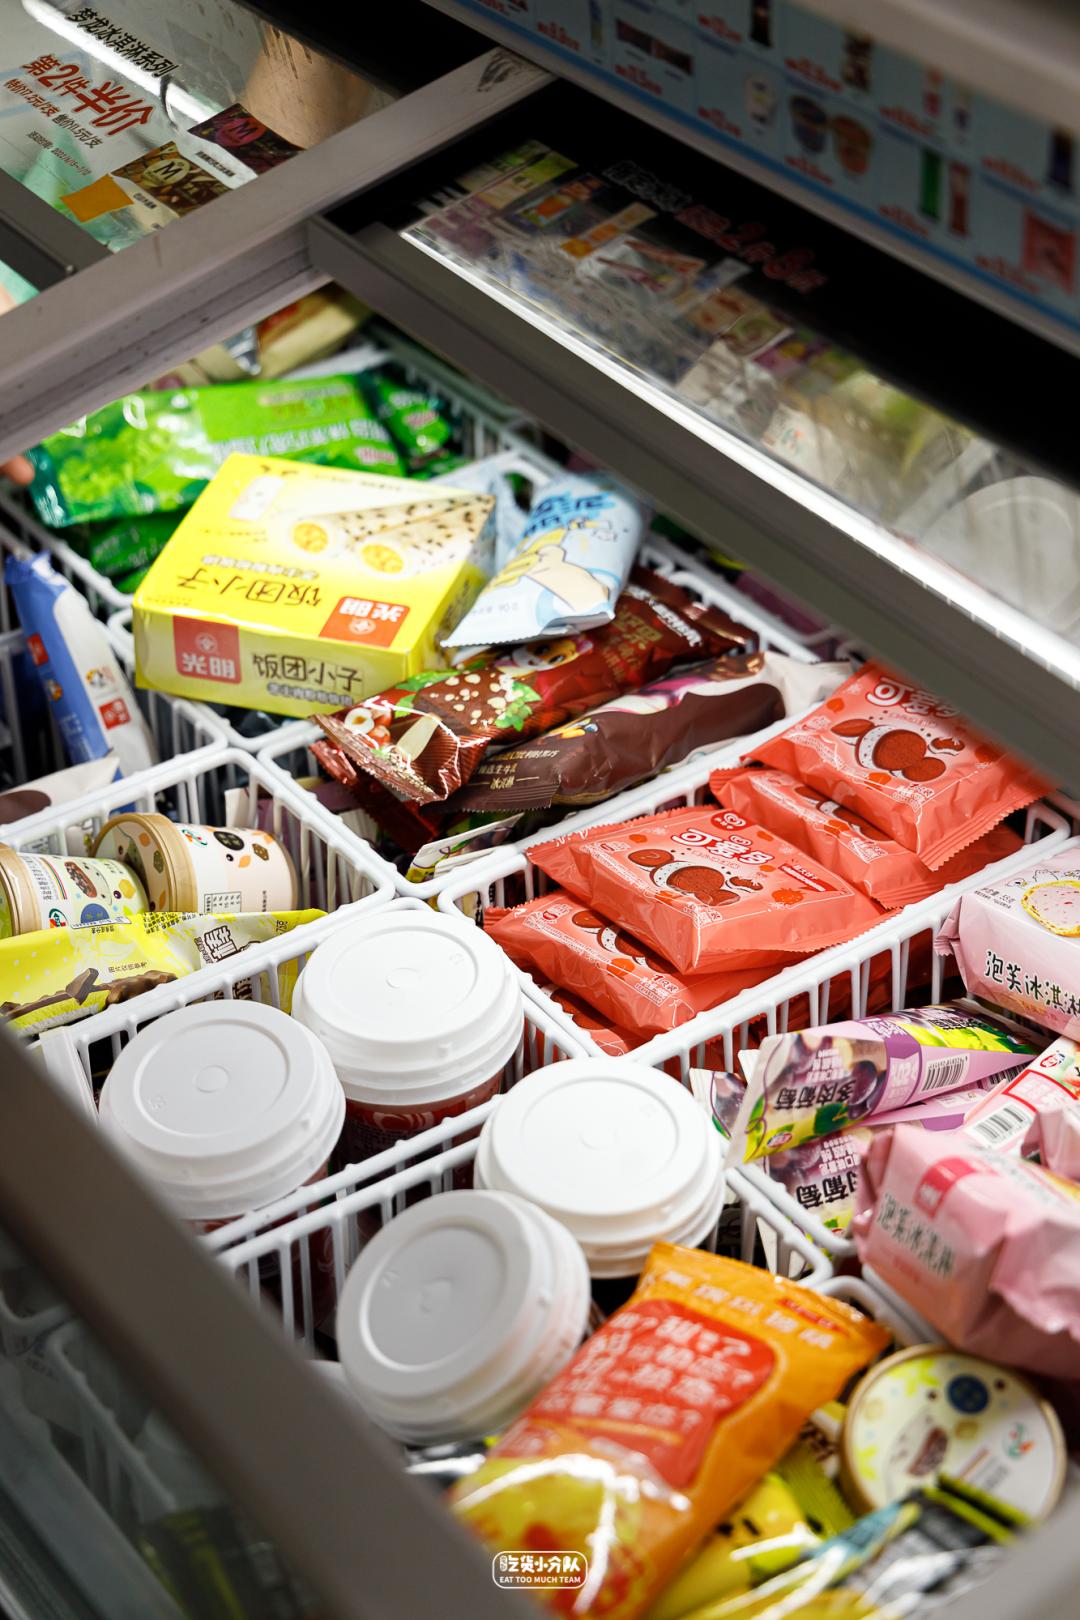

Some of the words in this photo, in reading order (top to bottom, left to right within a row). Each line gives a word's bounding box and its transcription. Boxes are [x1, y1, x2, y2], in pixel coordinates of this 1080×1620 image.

[66, 7, 179, 78] 梦龙冰淇淋系列
[22, 53, 154, 136] 第2件半价
[176, 567, 322, 607] 饭团小子
[339, 597, 403, 623] 光明
[182, 652, 236, 680] 光明
[252, 653, 363, 692] 饭团小子
[671, 828, 775, 865] 可爱多
[774, 1080, 857, 1110] 多肉葡萄
